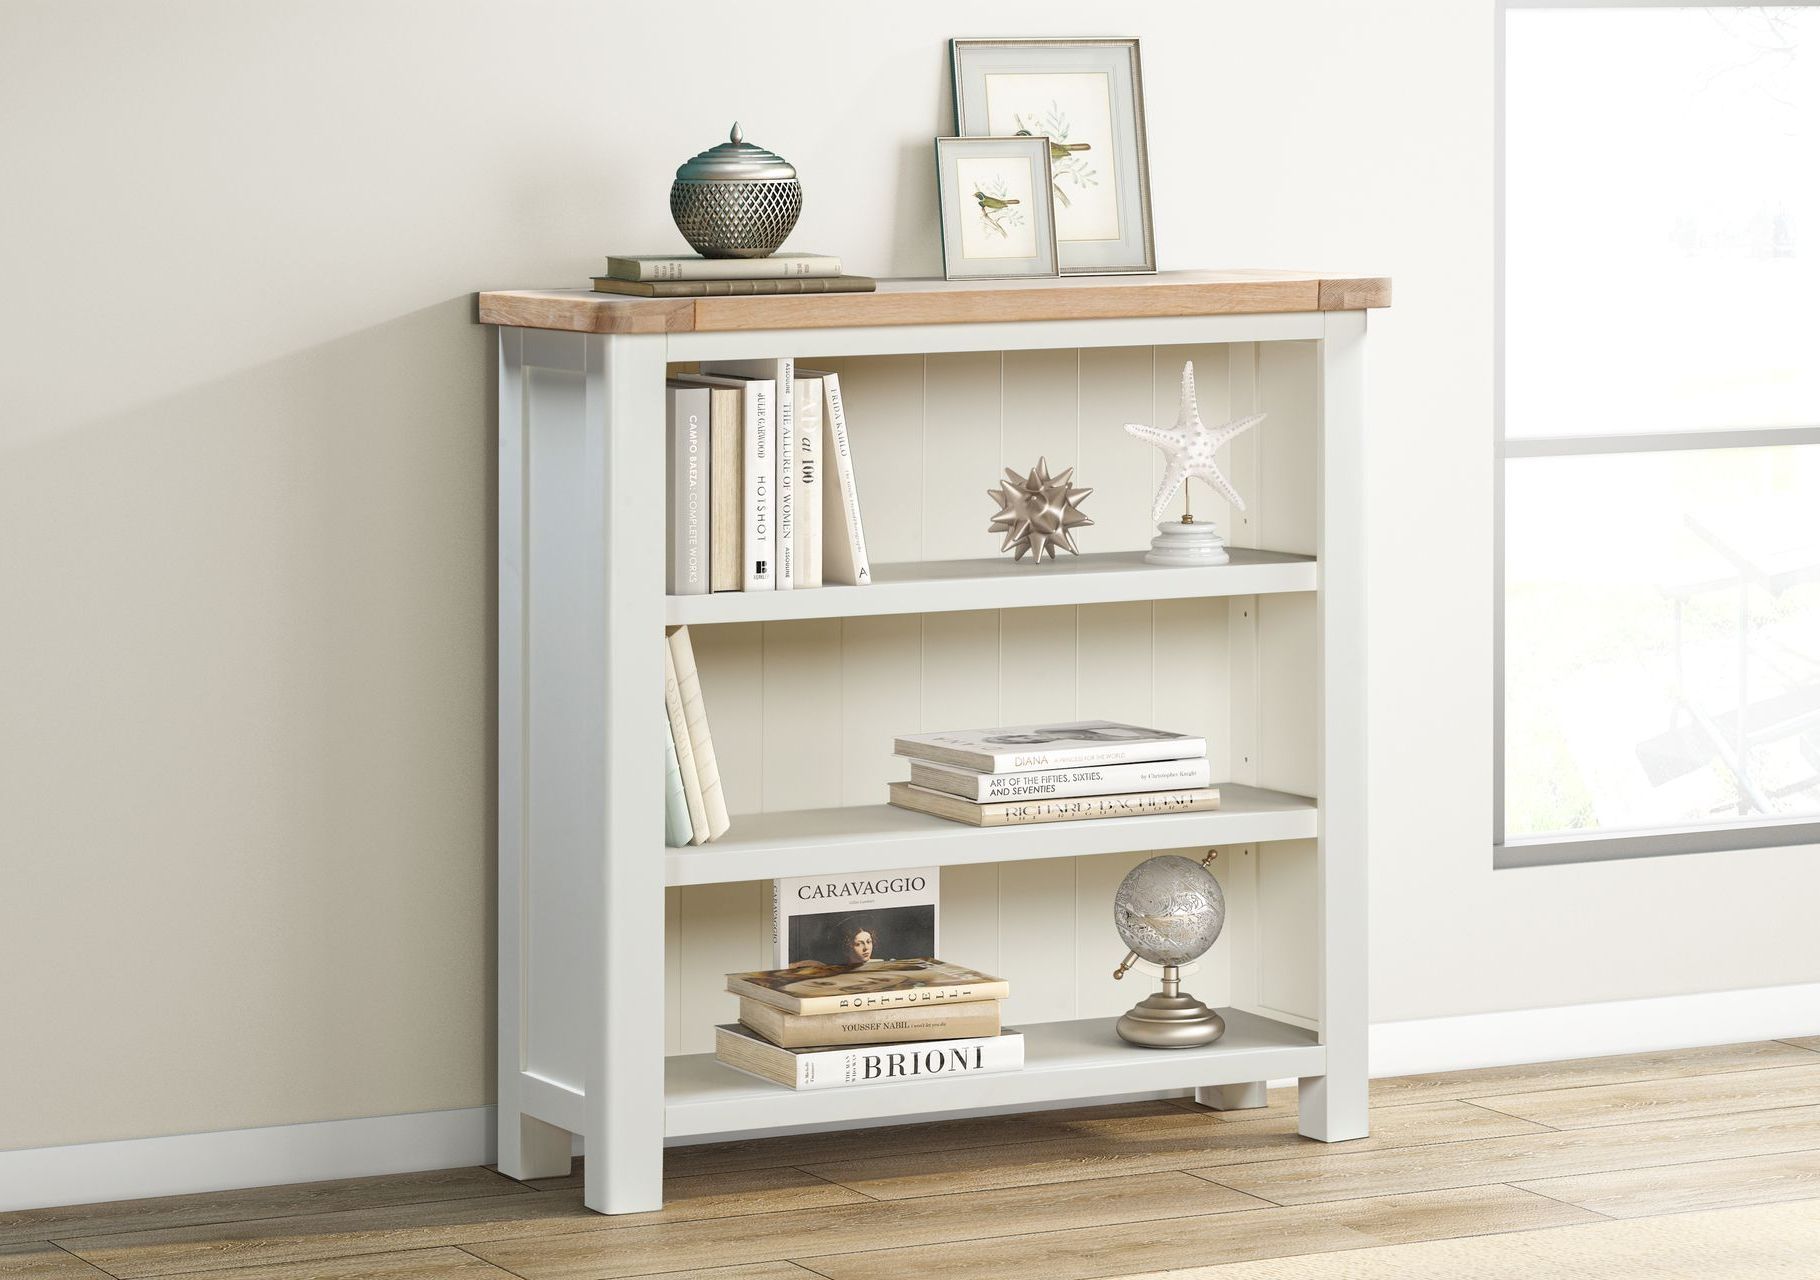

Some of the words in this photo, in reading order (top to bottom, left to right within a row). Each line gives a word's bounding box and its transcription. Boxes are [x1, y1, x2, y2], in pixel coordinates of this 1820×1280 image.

[756, 392, 766, 417] JULIE
[782, 402, 792, 425] THE
[830, 388, 842, 420] FRIDA
[689, 415, 697, 452] CAMPO
[756, 417, 766, 459] GARWOOD
[802, 437, 813, 453] at
[835, 421, 847, 457] KAHLO
[782, 426, 792, 474] ALLURE
[689, 455, 697, 490] BAEZA:
[782, 476, 792, 491] OF
[801, 459, 814, 485] 100
[689, 492, 697, 545] COMPLETE
[756, 475, 766, 543] HOTSHOT
[782, 494, 792, 539] WOMEN
[689, 547, 697, 584] WORKS
[1014, 754, 1049, 767] DIANA
[989, 777, 1007, 788] ART
[1008, 776, 1021, 787] OF
[1023, 775, 1039, 786] THE
[1040, 773, 1071, 785] FIFTIES,
[1072, 772, 1104, 784] SIXTIES,
[989, 786, 1010, 797] AND
[1012, 784, 1056, 796] SEVENTIES
[798, 876, 926, 900] CARAVAGGIO
[839, 990, 973, 1008] BOTTICELLI
[841, 1022, 881, 1033] YOUSSEF
[883, 1020, 910, 1032] NABIL
[862, 1045, 985, 1080] BRIONI
